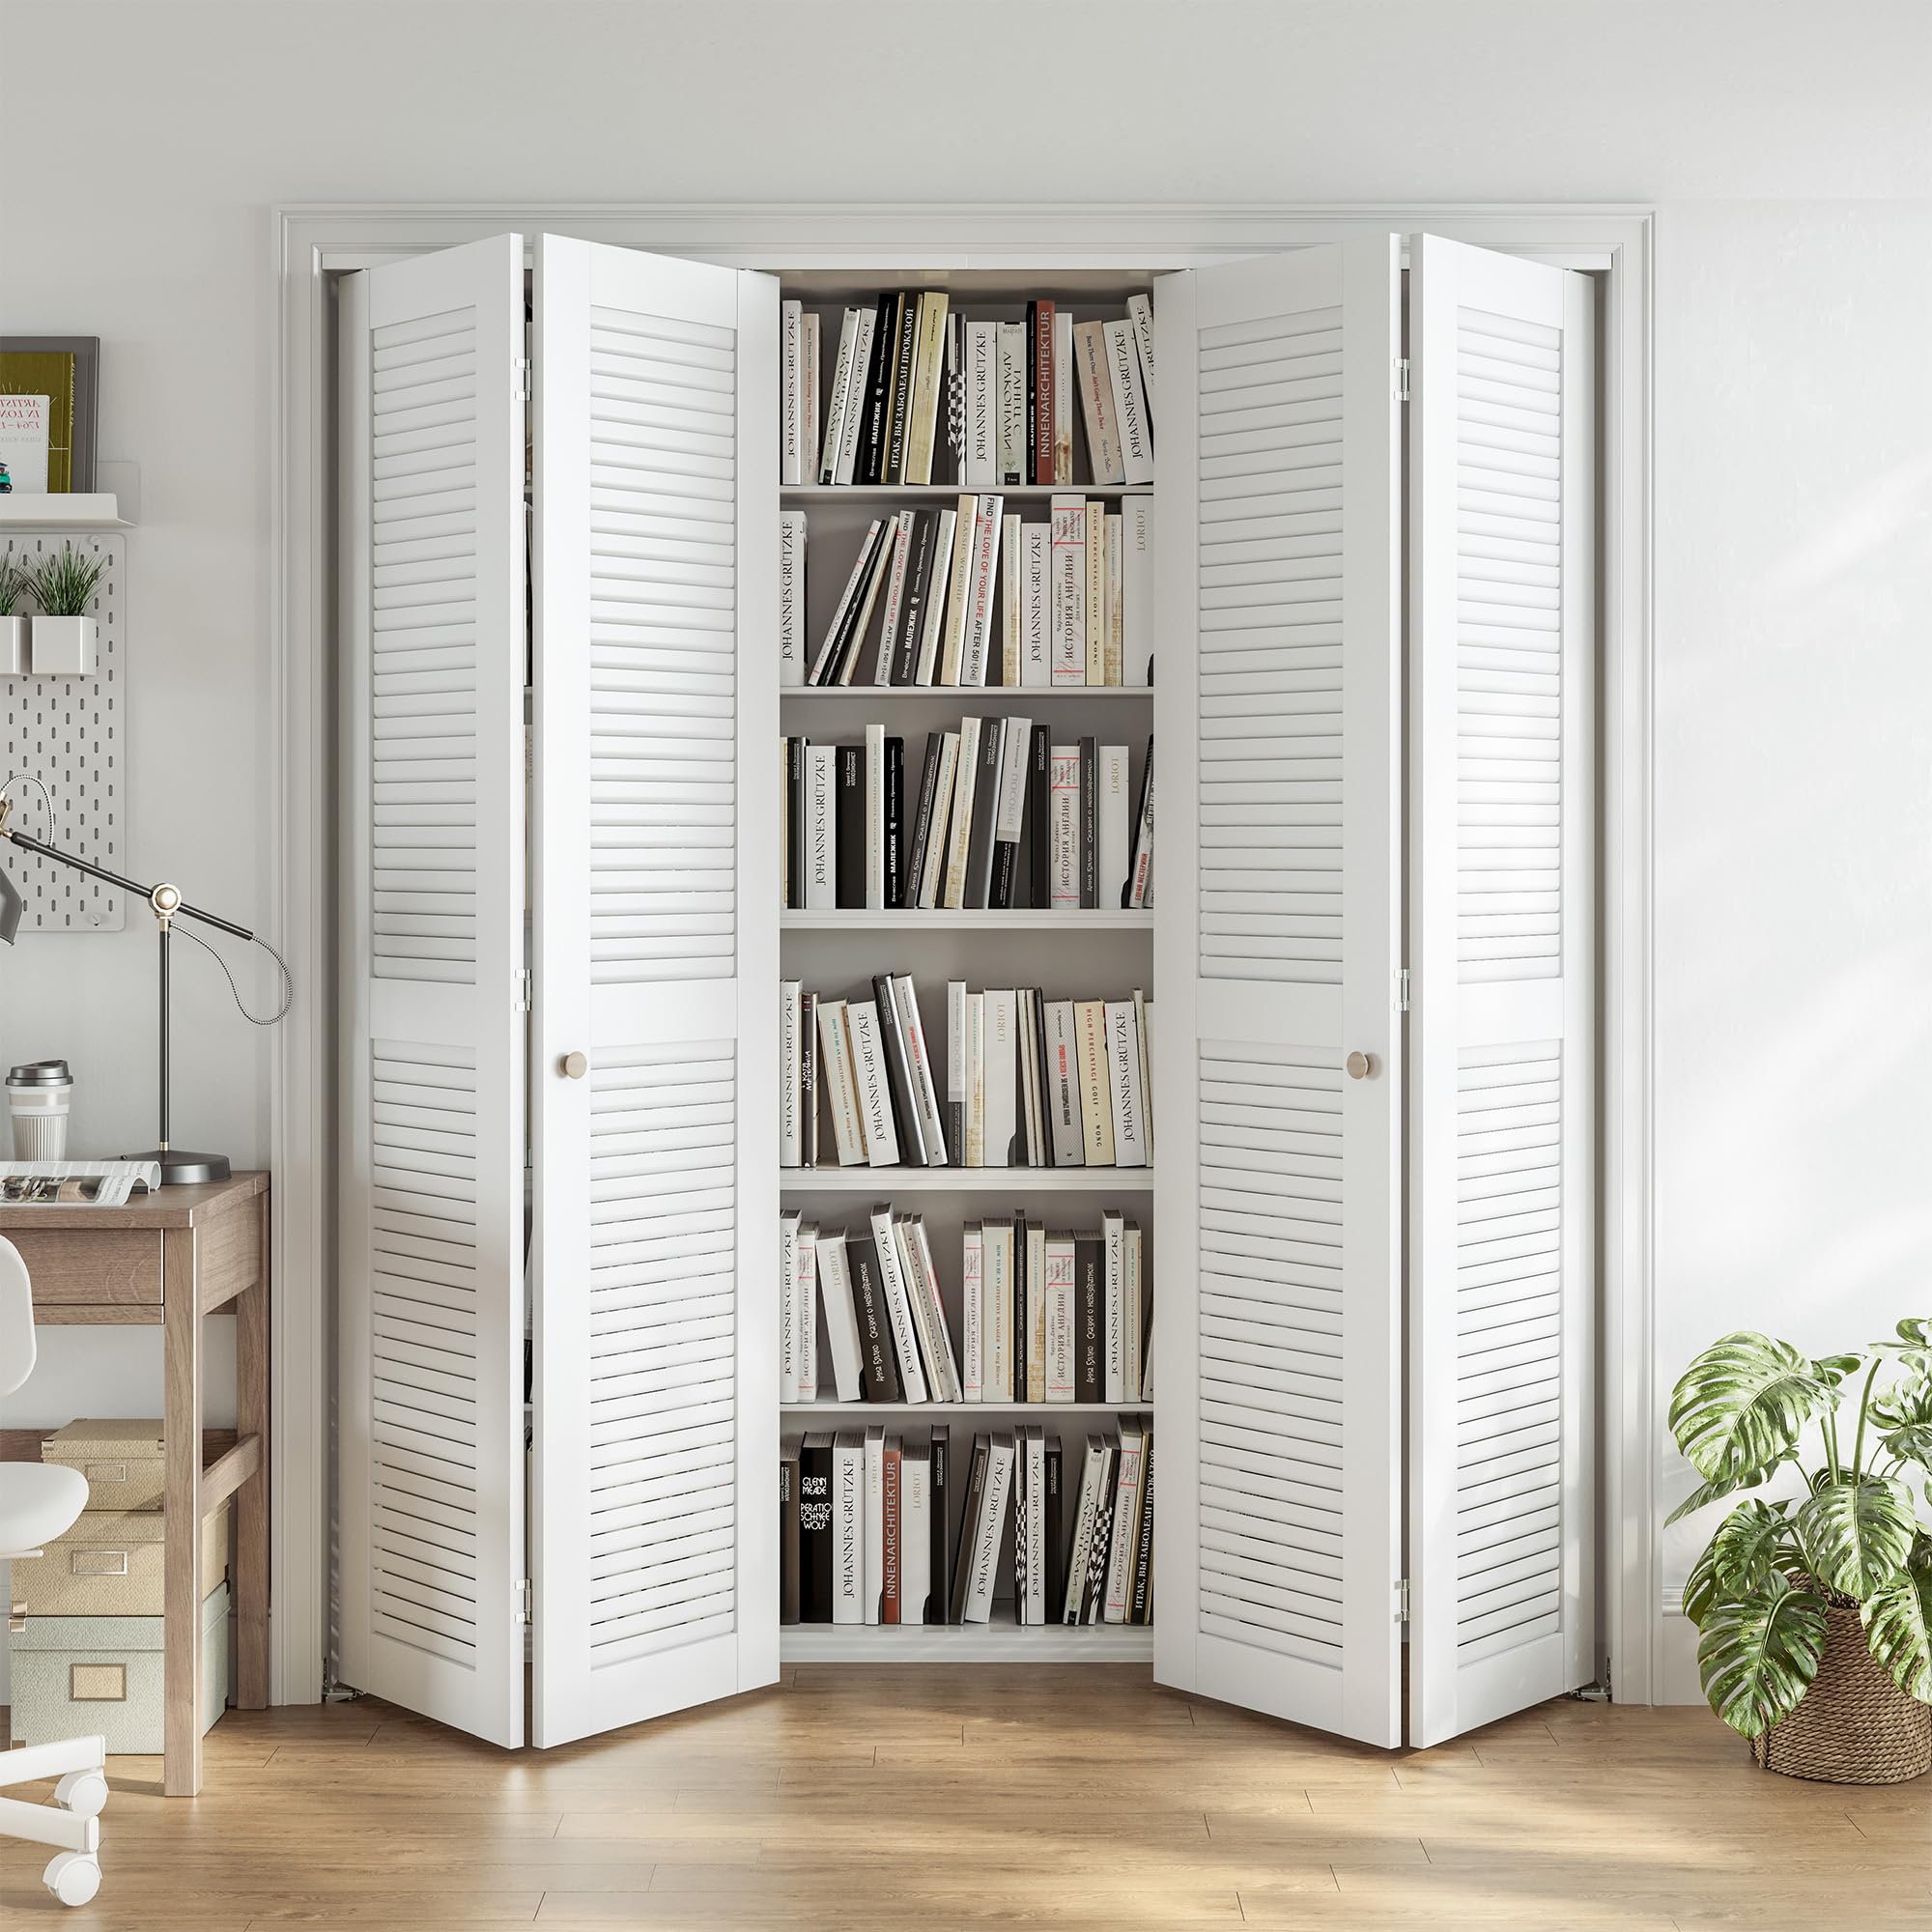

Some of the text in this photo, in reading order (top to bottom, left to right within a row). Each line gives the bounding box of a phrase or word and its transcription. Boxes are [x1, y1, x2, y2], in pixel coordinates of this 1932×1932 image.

[891, 308, 914, 468] ИТАК, ВЫ ЗАБОЛЕЛИ ПРОКАЗОЙ
[1040, 312, 1050, 457] INNENARCHITEKTUR
[844, 386, 860, 458] JOHANNES
[871, 402, 881, 443] МАЛЕЖИК
[977, 394, 986, 461] JOHANNES
[1123, 392, 1143, 458] JOHANNES
[985, 497, 995, 517] FIND
[1136, 509, 1146, 551] LORIOT
[895, 572, 902, 582] OF
[897, 550, 906, 570] LOVE
[980, 561, 988, 573] OF
[976, 601, 984, 618] LIFE
[978, 576, 987, 598] YOUR
[1065, 554, 1073, 659] ИСТОРИЯ АНГЛИИ
[782, 588, 793, 660] JOHANNES
[884, 626, 894, 651] AFTER
[904, 610, 918, 649] МАЛЕЖИК
[973, 620, 982, 647] AFTER
[1031, 595, 1041, 663] JOHANNES
[971, 649, 980, 662] 50!
[815, 818, 826, 885] JOHANNES
[997, 1004, 1006, 1042] LORIOT
[1088, 1033, 1096, 1082] PERCENTAGE
[867, 1075, 887, 1140] JOHANNES
[1121, 1075, 1135, 1141] JOHANNES
[829, 1250, 841, 1286] LORIOT
[894, 1297, 915, 1375] JOHANNES
[803, 1477, 827, 1487] GLENN
[801, 1503, 832, 1513] PERATIO
[804, 1520, 826, 1530] WOLF
[887, 1462, 896, 1599] INNENARCHITEKTUR
[843, 1526, 855, 1598] JOHANNES
[977, 1524, 995, 1596] JOHANNES
[1135, 1507, 1152, 1608] ИТАК, ВЫ ЗАБОЛЕЛИ
